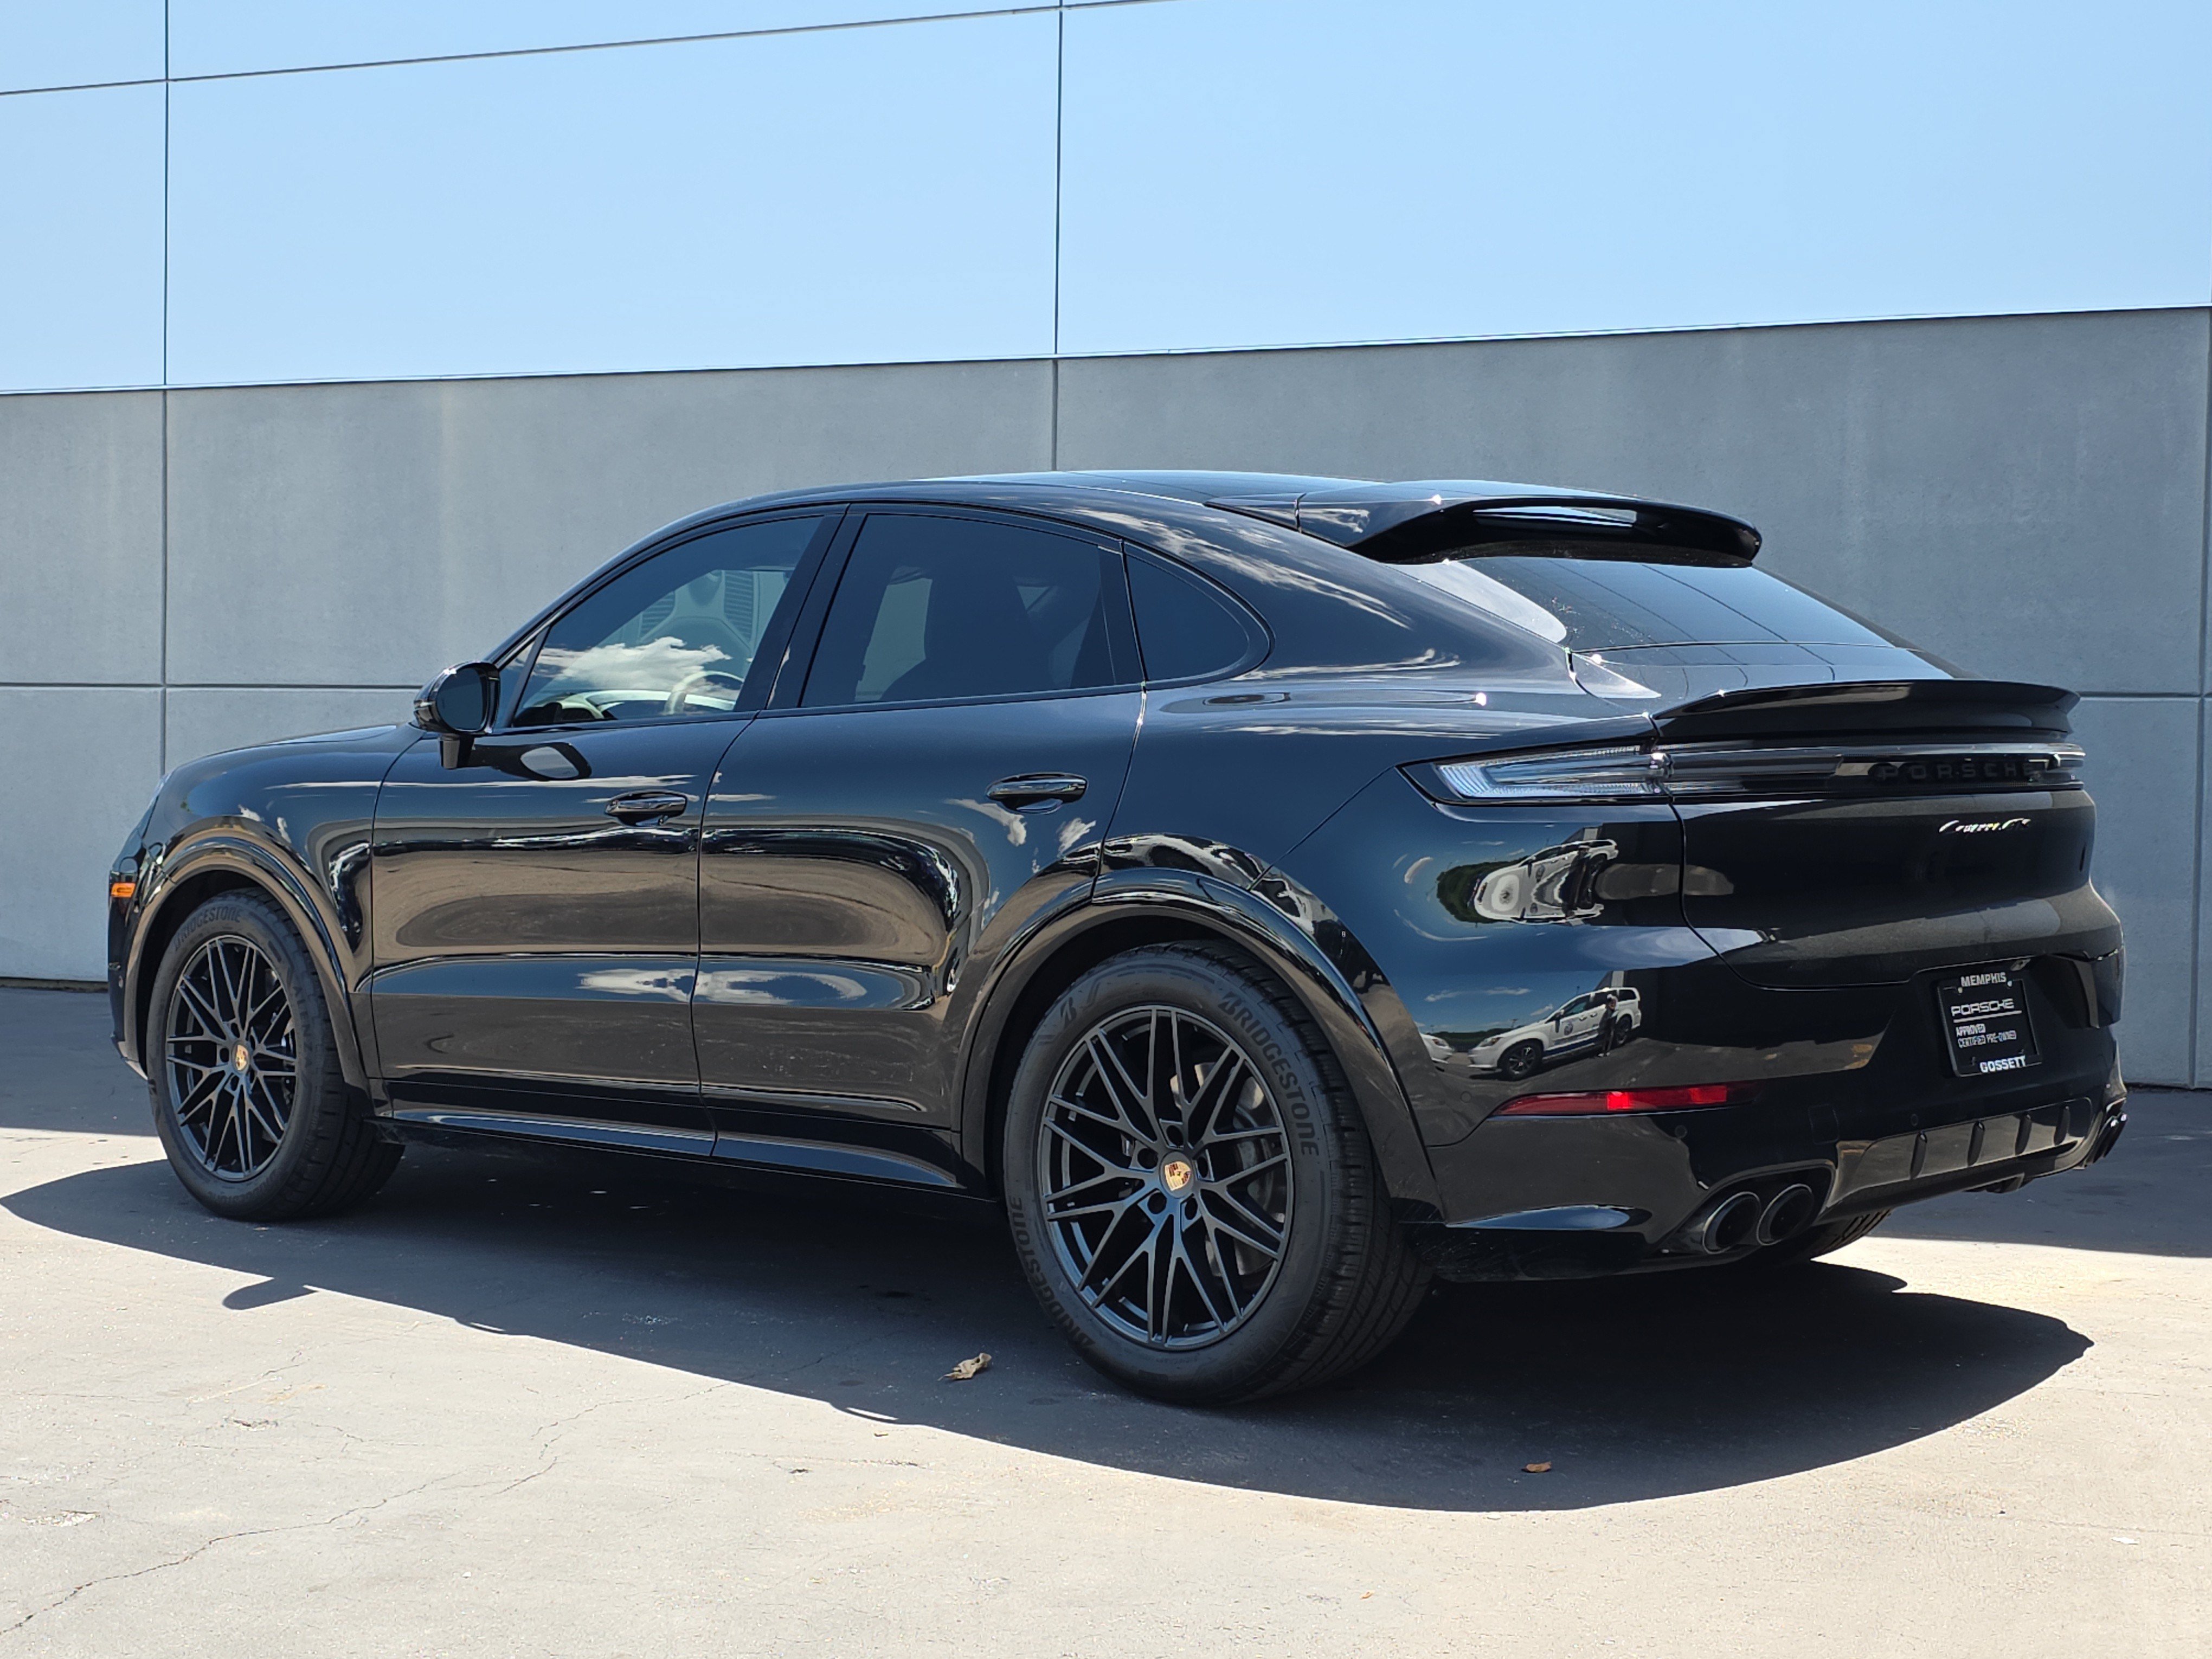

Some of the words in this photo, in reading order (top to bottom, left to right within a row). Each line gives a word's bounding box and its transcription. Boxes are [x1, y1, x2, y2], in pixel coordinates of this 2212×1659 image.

[1876, 762, 2036, 781] PORSCHE
[1960, 972, 2007, 987] MEMPHIS
[1951, 998, 2015, 1017] PORSCHE
[1955, 1023, 1986, 1038] APPROVED
[1957, 1034, 1986, 1049] CERTIFIED
[1985, 1030, 2017, 1043] PRE-OWNED
[1217, 991, 1320, 1156] BRIDGESTONE
[1979, 1056, 2026, 1073] GOSSETT
[1008, 1195, 1096, 1347] BRIDGESTONE
